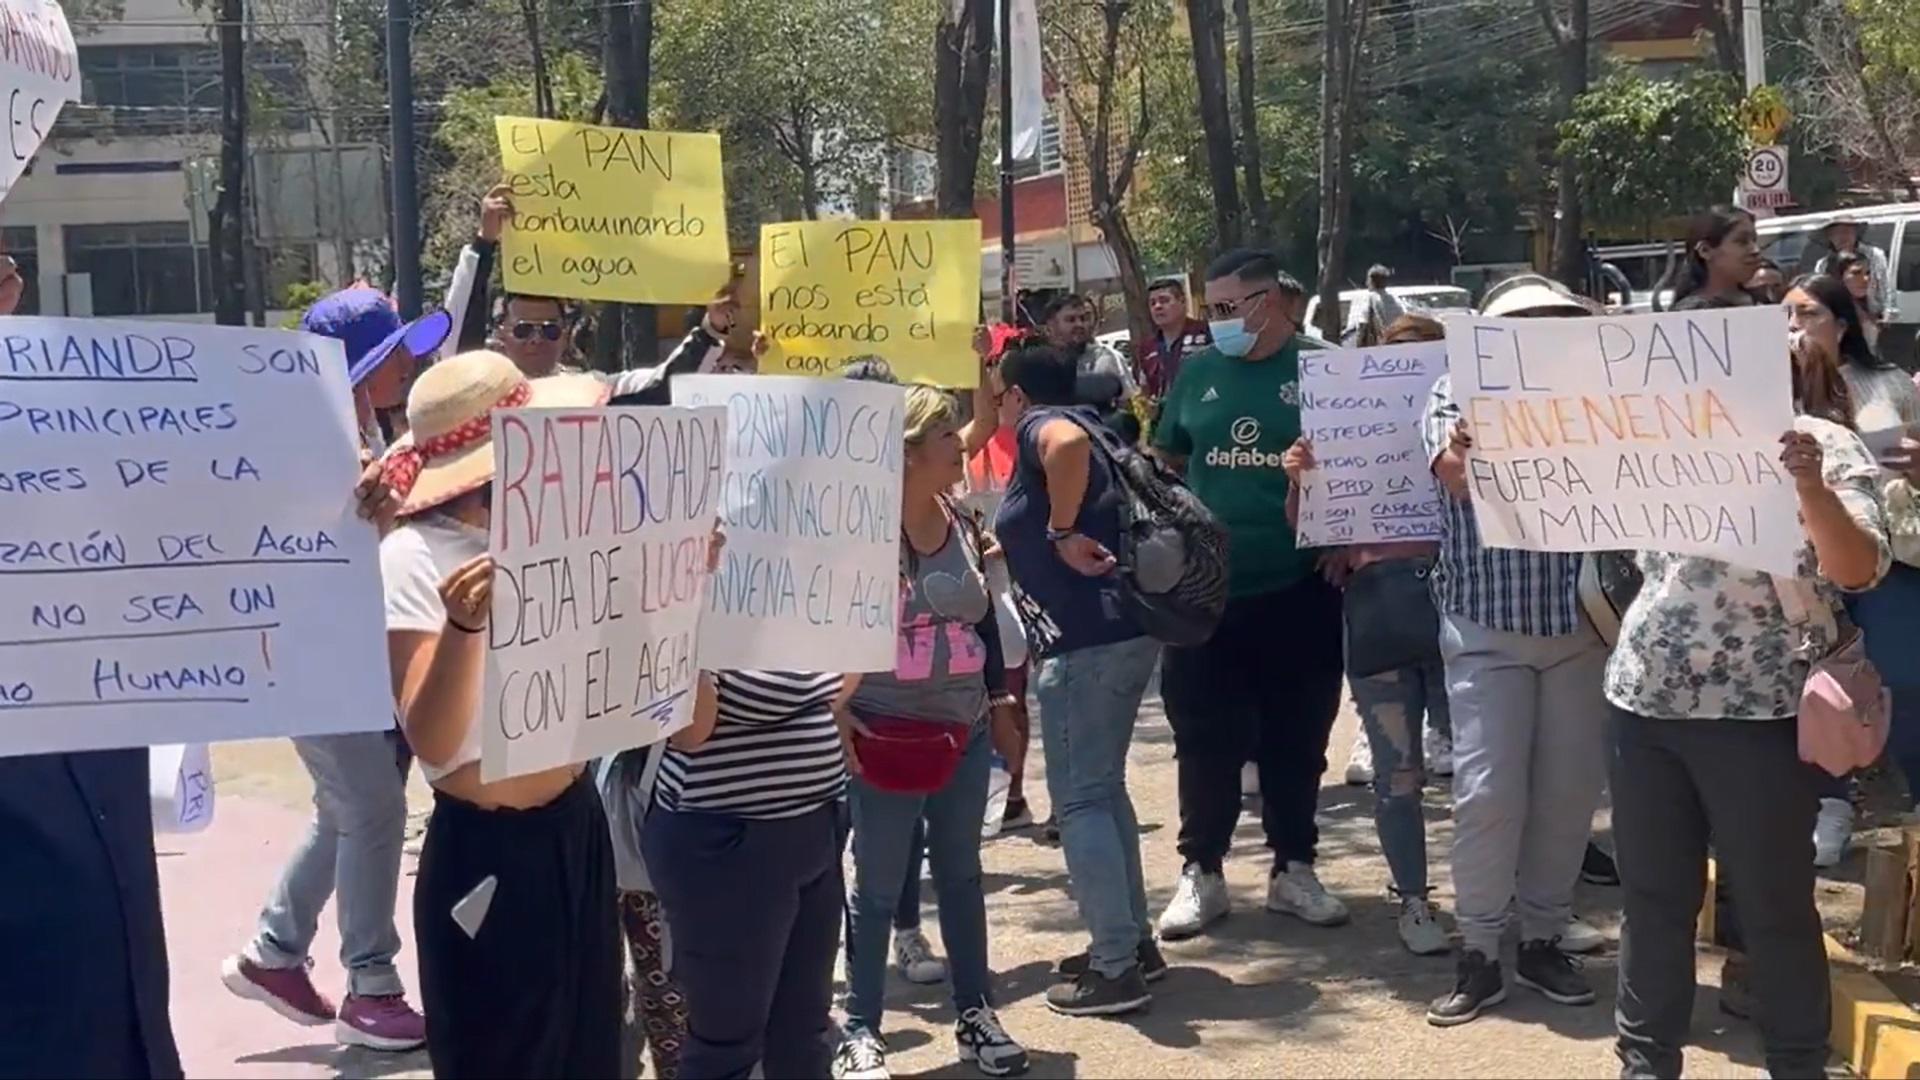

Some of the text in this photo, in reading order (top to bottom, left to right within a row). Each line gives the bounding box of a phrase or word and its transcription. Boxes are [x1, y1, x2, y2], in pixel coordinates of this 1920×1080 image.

[575, 128, 672, 181] PAN
[1755, 159, 1775, 171] 20
[509, 164, 581, 200] esta
[512, 244, 637, 285] el agua
[835, 228, 933, 274] PAN
[769, 277, 930, 311] nos está
[771, 312, 936, 342] robando el
[239, 344, 320, 375] SON
[1361, 355, 1426, 374] AGUA
[1474, 318, 1732, 391] EL PAN
[1403, 394, 1415, 408] Y
[728, 393, 788, 458] PAN
[801, 397, 842, 460] NO
[116, 459, 168, 487] DE
[211, 457, 260, 481] LA
[501, 413, 722, 550] RATABOADA
[1387, 475, 1415, 489] LA
[1471, 451, 1783, 504] FUERA ALCALDIA
[159, 534, 225, 562] DEL
[253, 525, 337, 557] AGUA
[33, 584, 276, 629] NO SEA UN
[489, 556, 579, 650] DEJA
[590, 546, 622, 624] DE
[807, 565, 833, 625] EL
[500, 663, 566, 740] CON
[585, 648, 621, 718] EL
